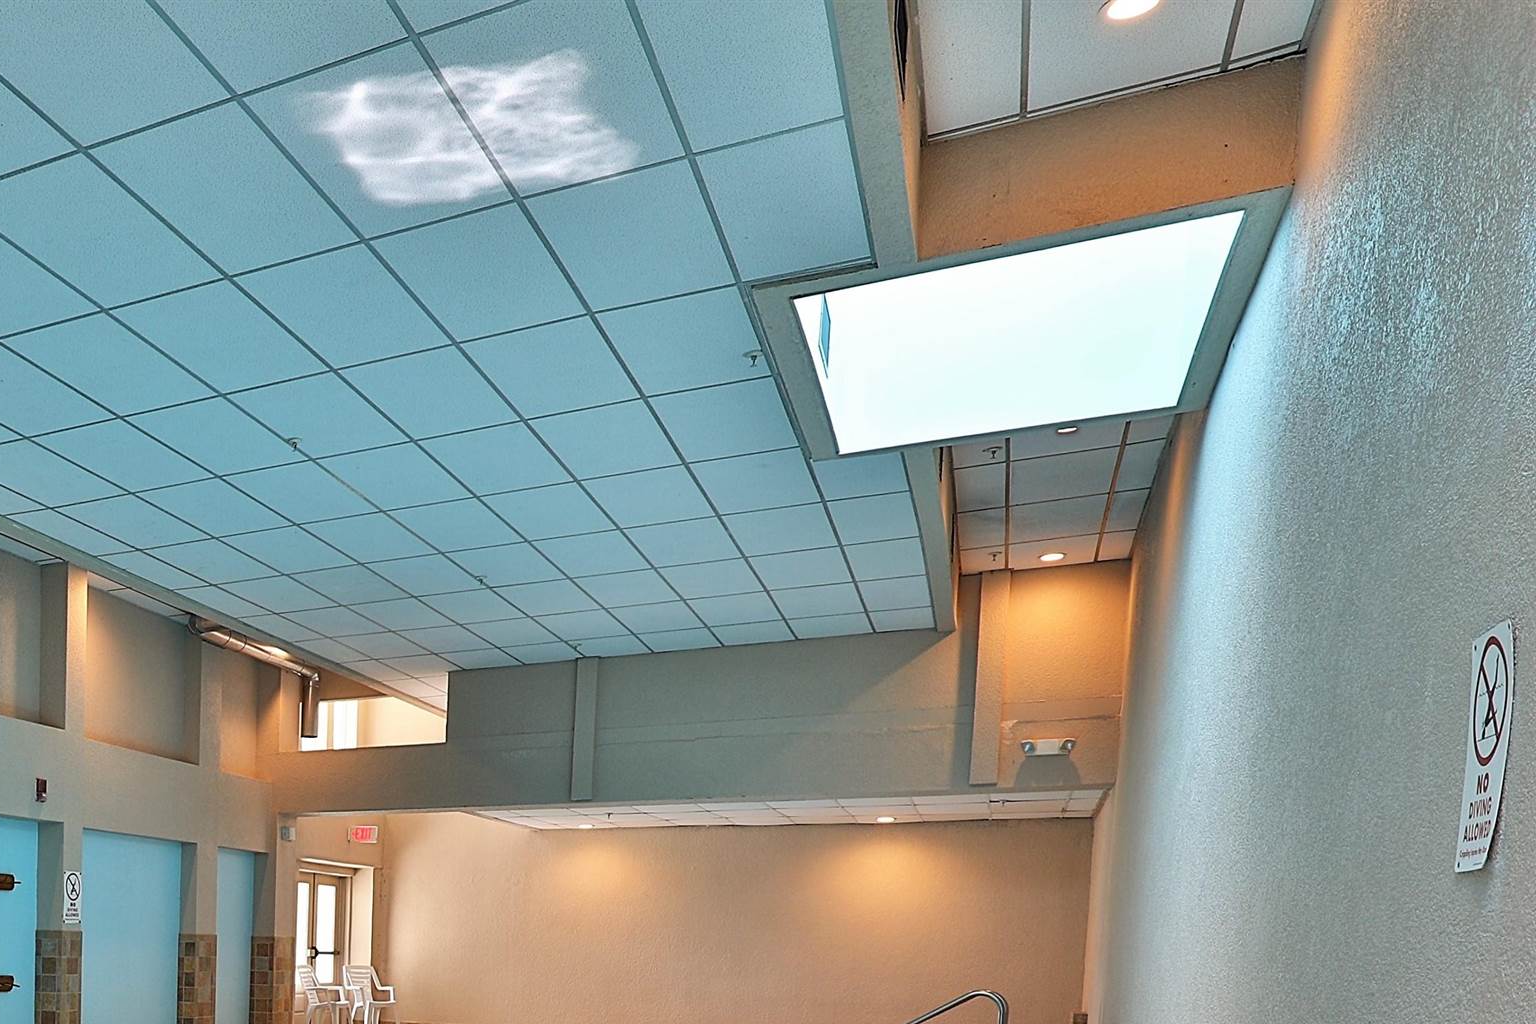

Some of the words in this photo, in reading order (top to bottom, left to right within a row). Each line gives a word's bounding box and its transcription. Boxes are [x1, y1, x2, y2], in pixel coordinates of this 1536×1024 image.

[1476, 772, 1490, 795] NO
[1468, 797, 1492, 820] DIVING
[1463, 820, 1491, 843] ALLOWED
